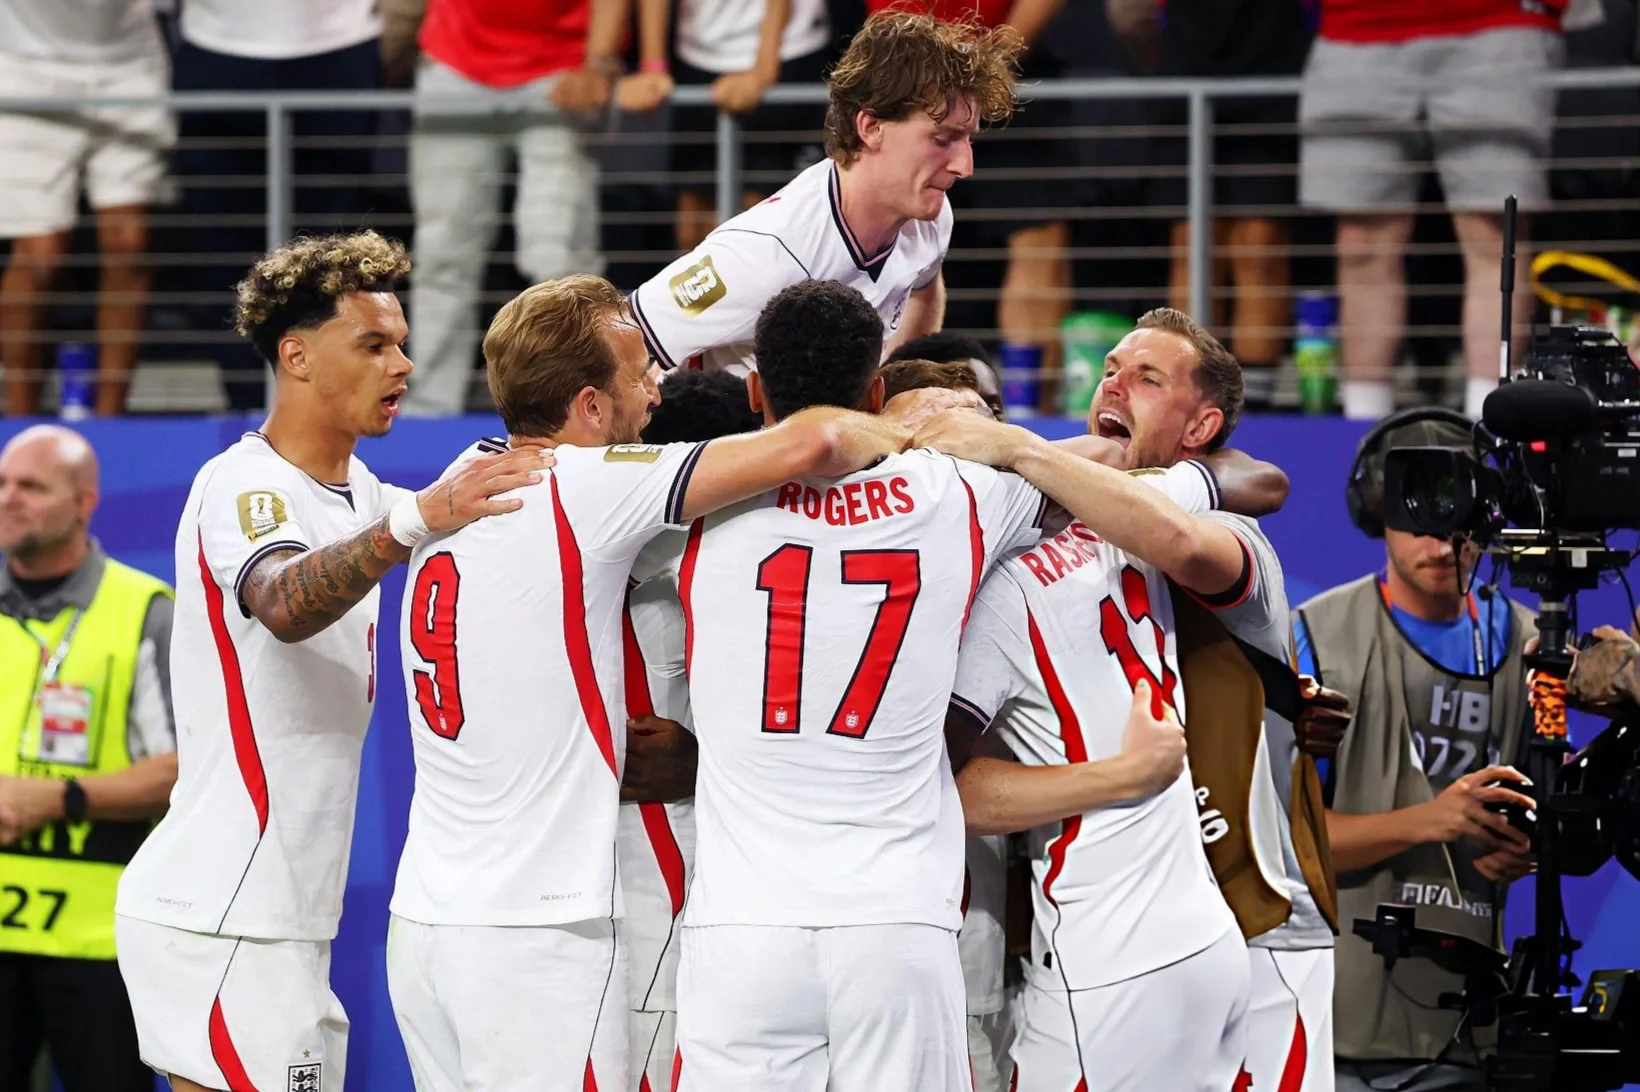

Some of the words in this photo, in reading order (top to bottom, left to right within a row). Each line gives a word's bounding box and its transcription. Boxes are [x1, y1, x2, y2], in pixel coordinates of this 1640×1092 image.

[776, 476, 915, 526] ROGERS
[410, 551, 465, 741] 9
[756, 543, 921, 739] 17
[1, 884, 70, 932] 27
